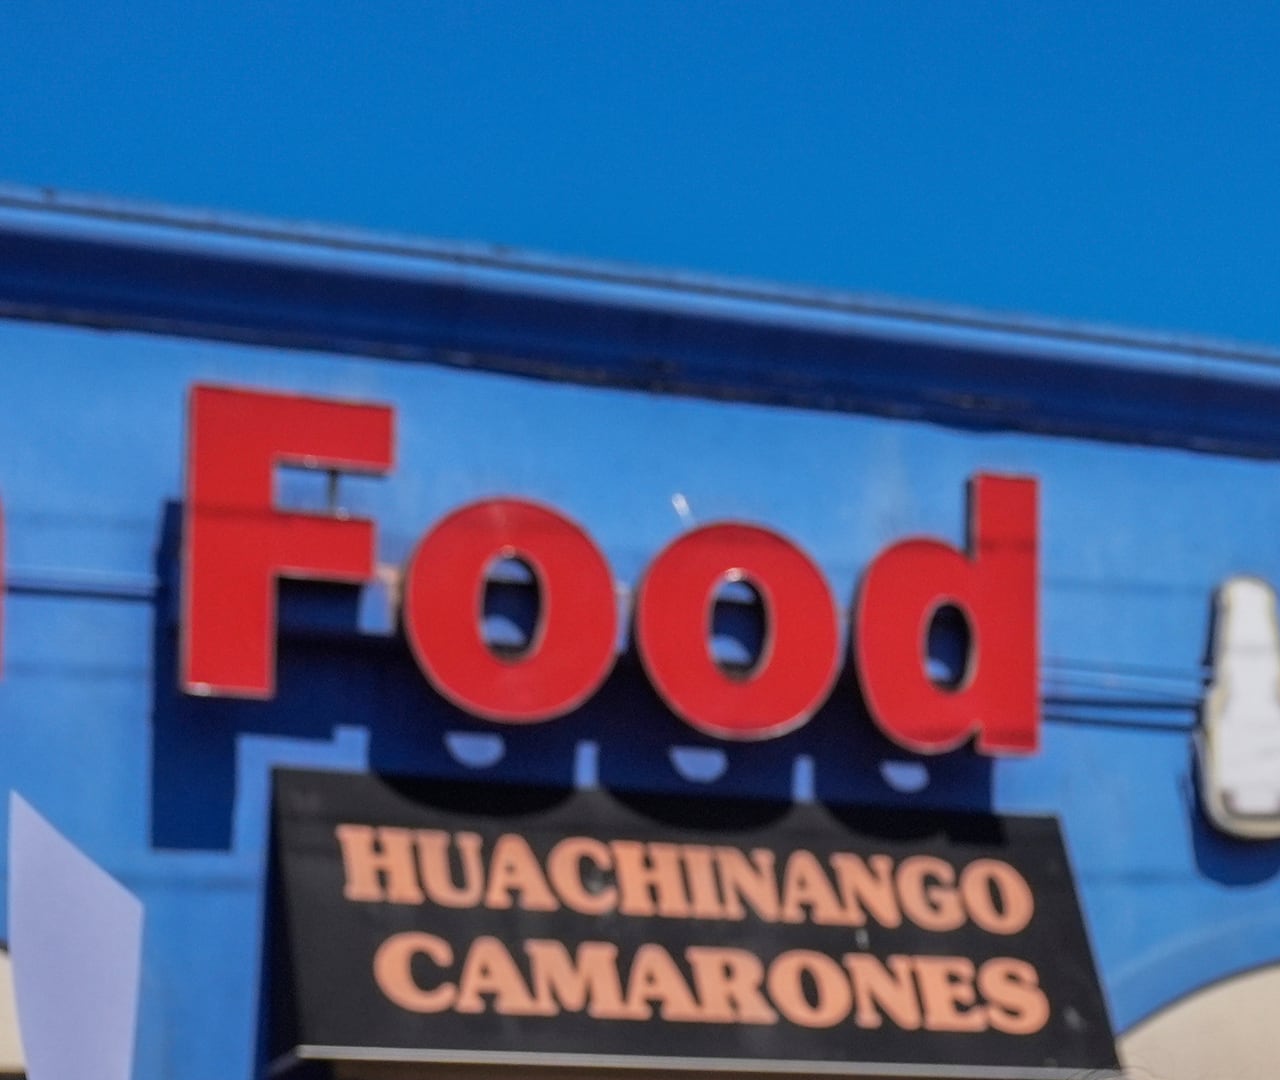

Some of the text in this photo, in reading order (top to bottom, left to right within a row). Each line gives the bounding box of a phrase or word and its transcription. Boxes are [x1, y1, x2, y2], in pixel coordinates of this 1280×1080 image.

[181, 382, 1040, 755] Food
[336, 823, 1034, 935] HUACHINANGO
[373, 930, 1051, 1036] CAMARONES
